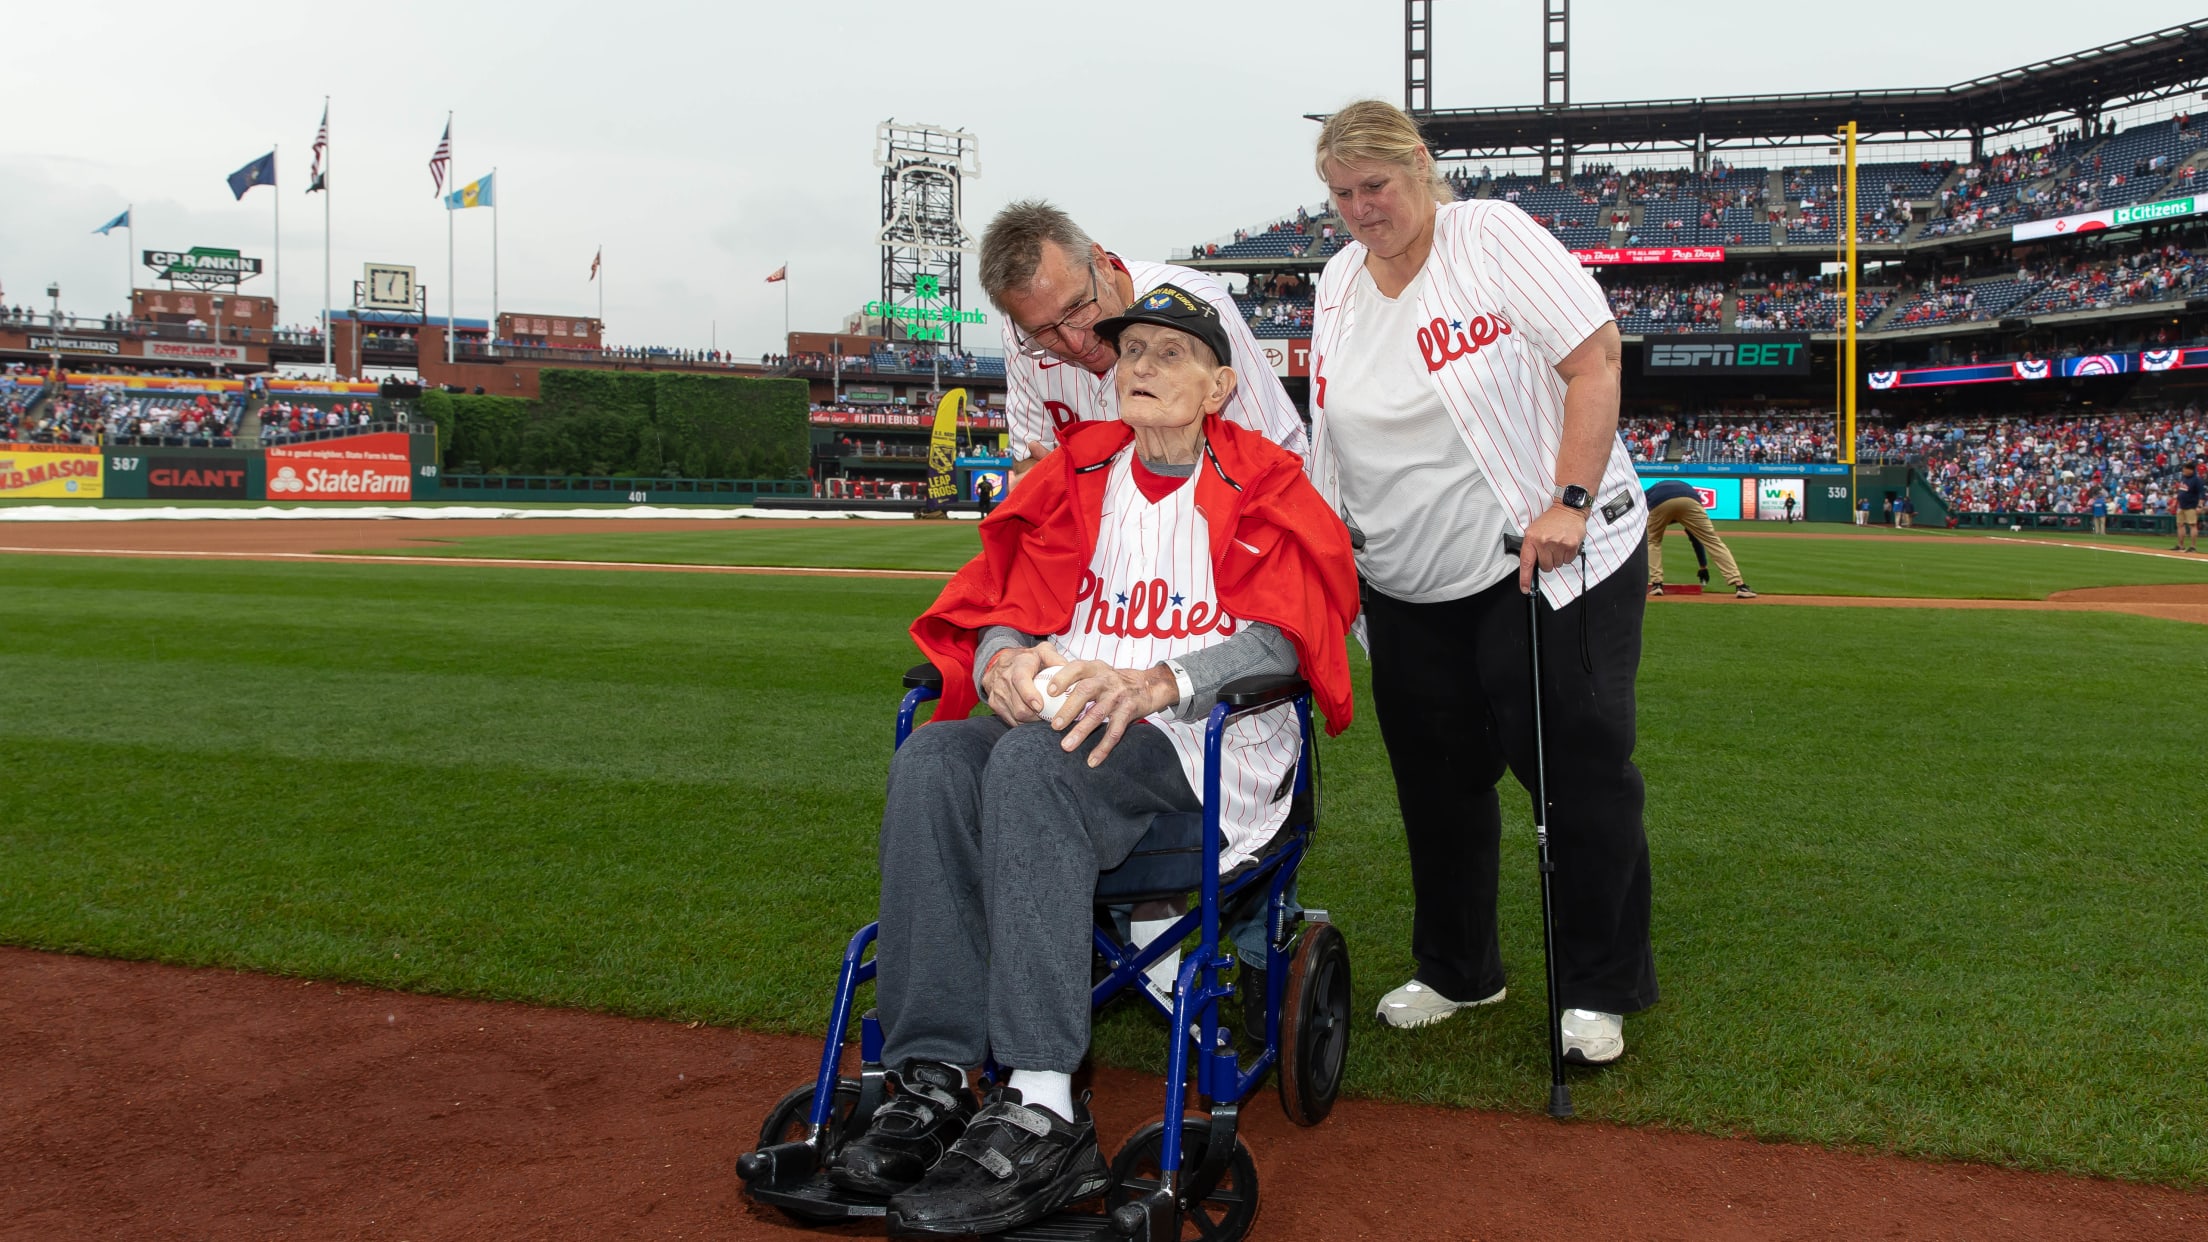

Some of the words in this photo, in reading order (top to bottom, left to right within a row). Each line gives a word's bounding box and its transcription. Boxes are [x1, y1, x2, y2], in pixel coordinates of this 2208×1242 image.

[2132, 201, 2187, 220] Citizens
[151, 253, 180, 265] CP
[182, 254, 254, 271] RANKIN
[1594, 251, 1620, 262] Boys
[1672, 249, 1689, 260] Pep
[1691, 248, 1721, 261] Boys
[171, 271, 236, 283] ROOFTOP
[1161, 287, 1176, 297] AIR
[1174, 292, 1198, 312] CORPS
[866, 301, 938, 320] Citizens
[942, 306, 985, 324] Bank
[906, 323, 945, 340] Park
[1651, 344, 1735, 366] ESPN
[1736, 343, 1803, 366] BET
[112, 457, 139, 471] 387
[149, 468, 245, 487] GIANT
[420, 466, 437, 478] 409
[928, 474, 951, 488] LEAP
[629, 491, 647, 503] 401
[928, 484, 958, 499] FROGS
[1827, 487, 1847, 499] 330
[1056, 569, 1237, 639] Phillies
